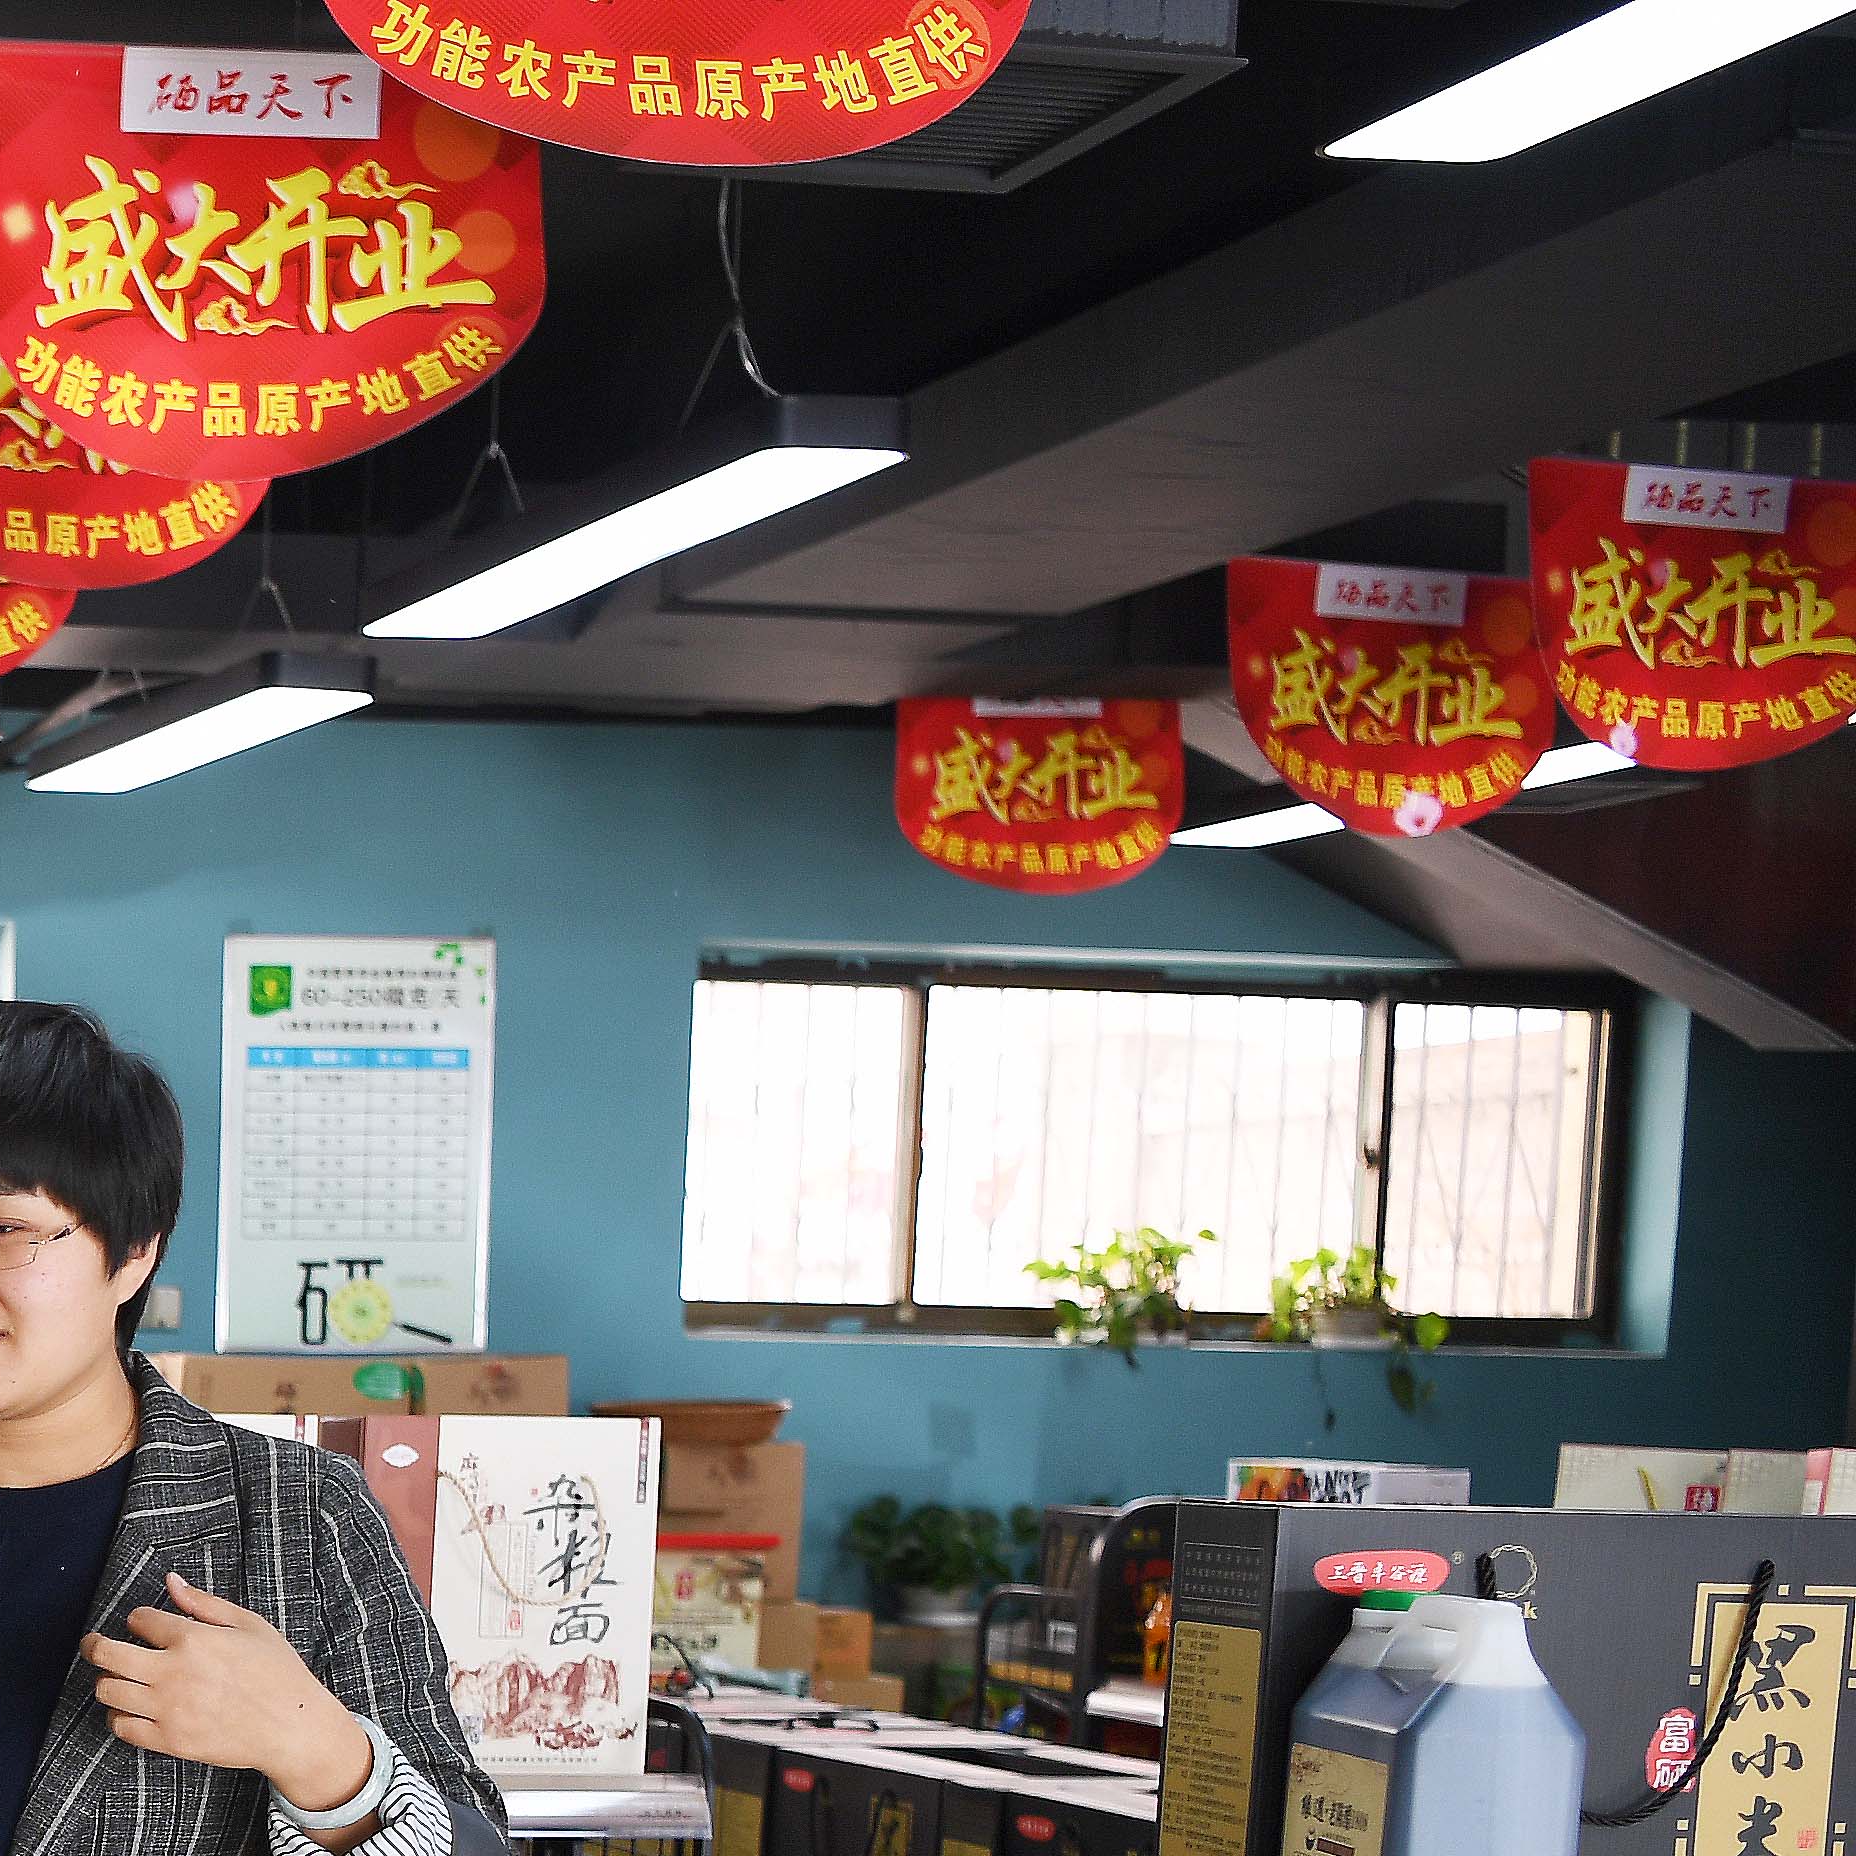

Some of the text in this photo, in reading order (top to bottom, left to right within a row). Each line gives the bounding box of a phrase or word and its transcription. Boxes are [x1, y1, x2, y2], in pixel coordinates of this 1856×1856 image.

[371, 3, 988, 121] 功能农产品原产地直供
[36, 155, 496, 342] 盛大开业
[14, 314, 502, 438] 功能农产品原产地直供
[1564, 535, 1856, 671] 盛大开业
[1270, 628, 1524, 747] 盛大开业
[1556, 660, 1856, 741] 功能农产品原产地直供
[929, 726, 1160, 826] 盛大开业
